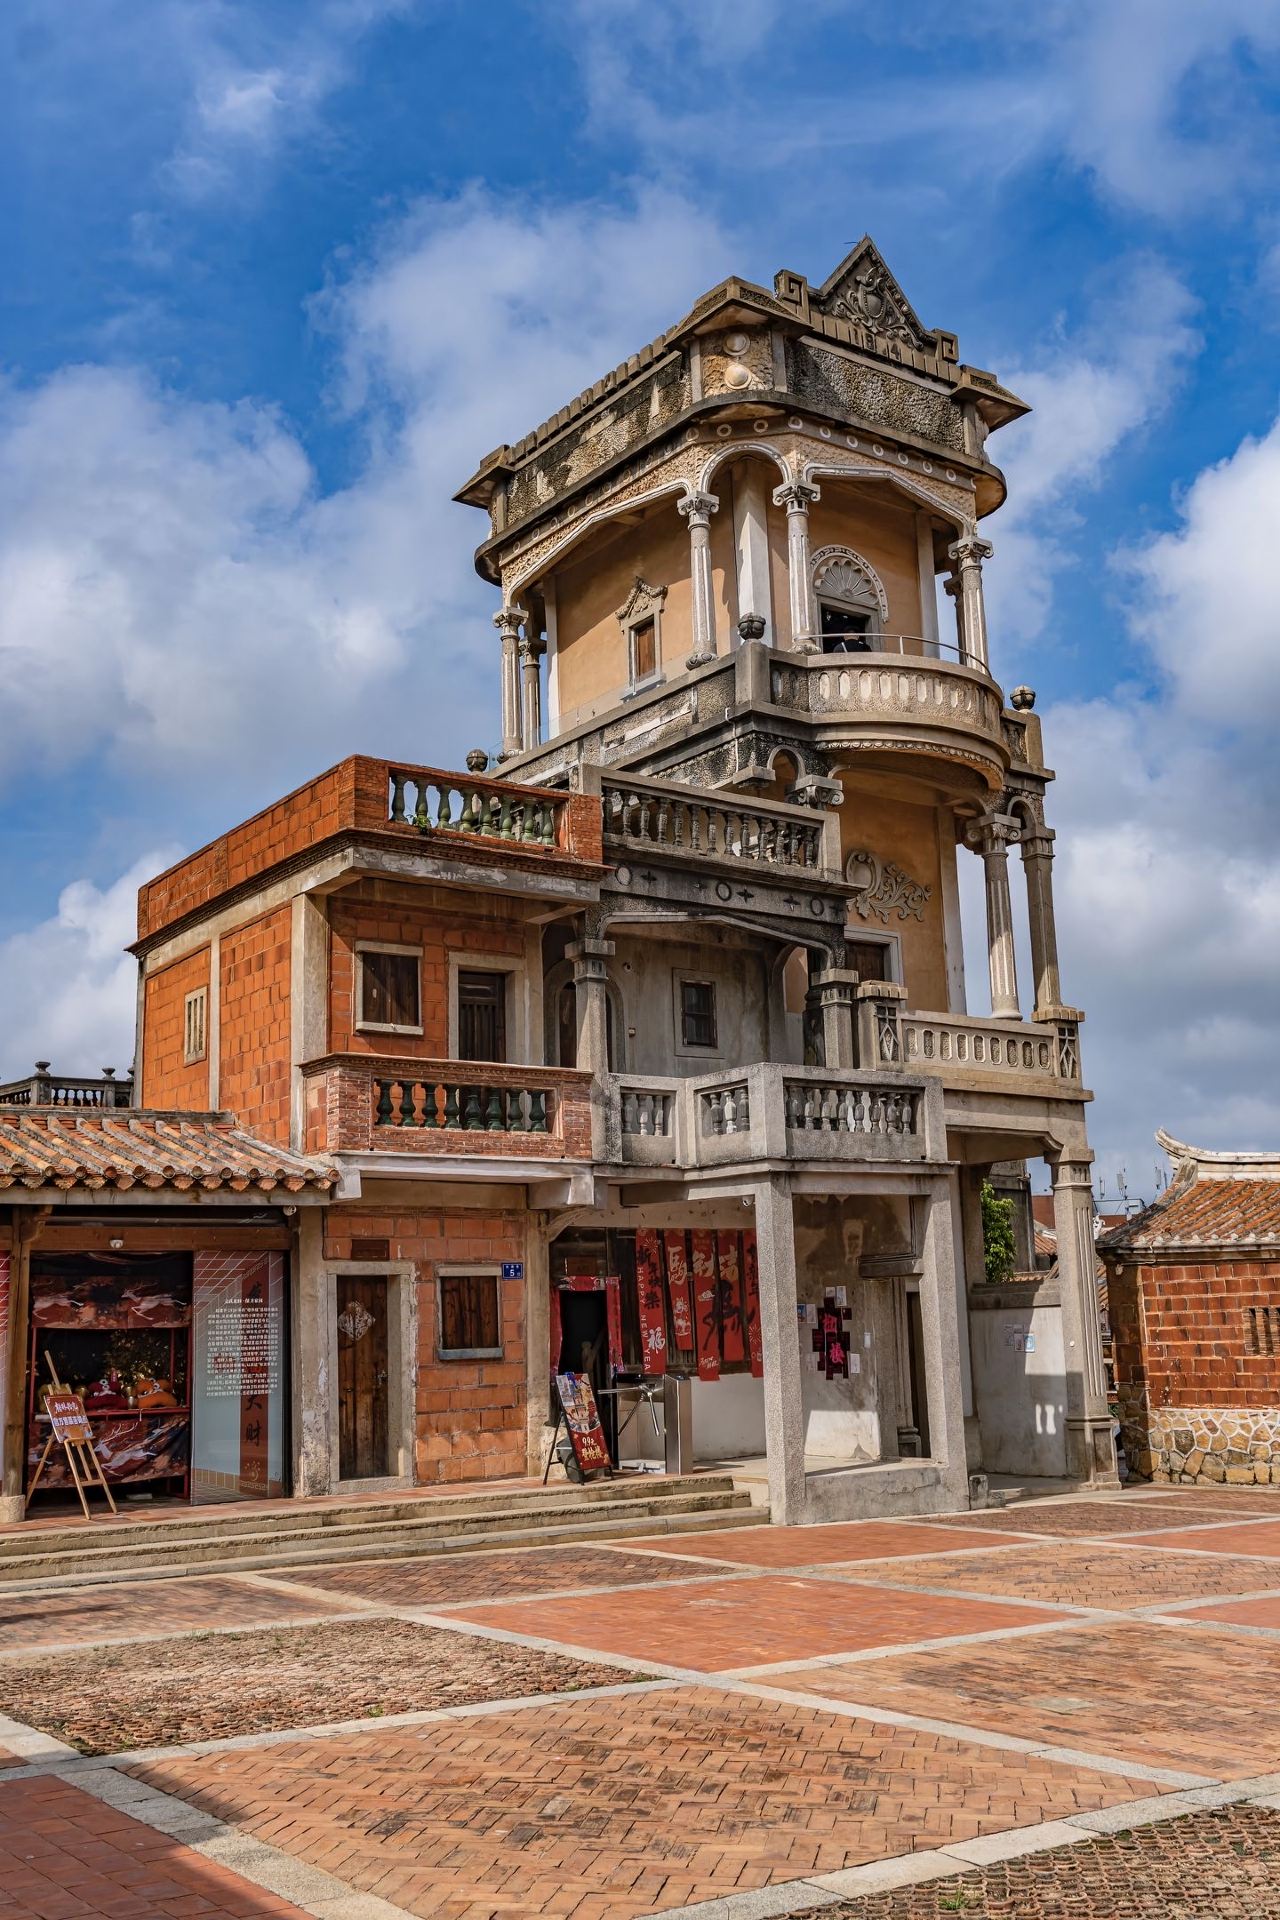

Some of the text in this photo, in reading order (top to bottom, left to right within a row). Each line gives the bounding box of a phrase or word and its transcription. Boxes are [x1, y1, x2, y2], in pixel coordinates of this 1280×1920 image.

[636, 1266, 652, 1374] HAPPY NEW YEA
[647, 1326, 665, 1355] 福
